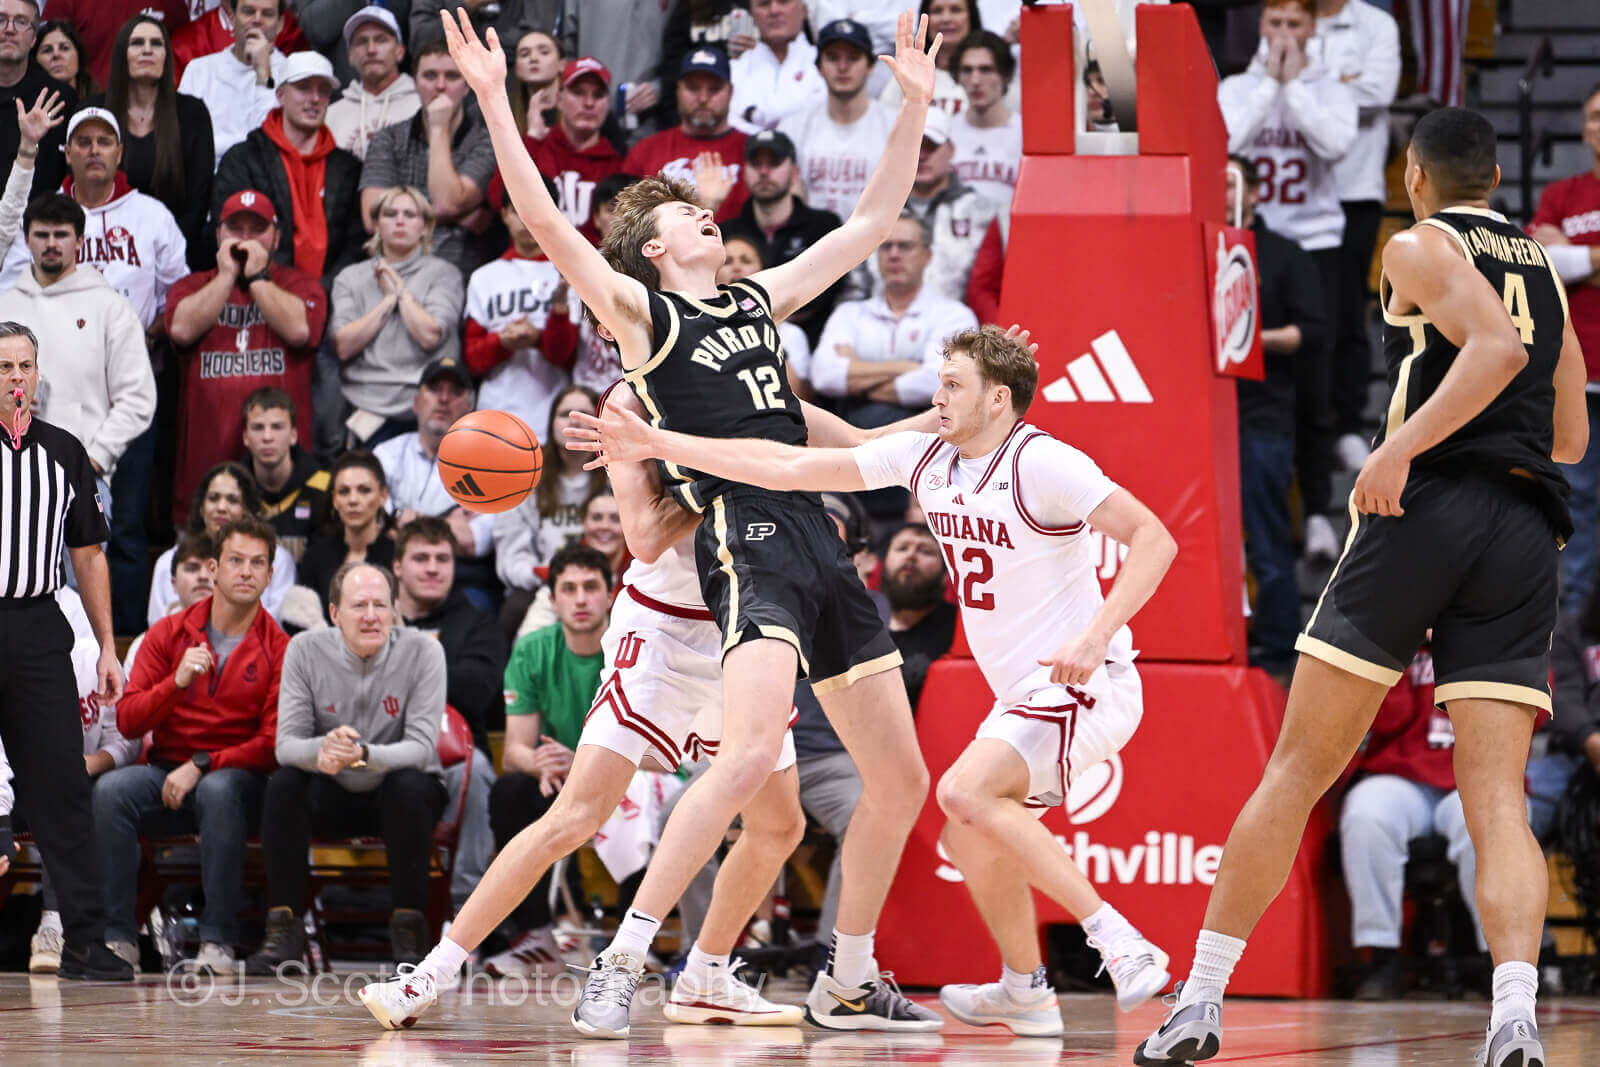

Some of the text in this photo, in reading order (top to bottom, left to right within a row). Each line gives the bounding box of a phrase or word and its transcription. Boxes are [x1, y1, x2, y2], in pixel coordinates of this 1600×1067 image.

[75, 235, 142, 267] DIANA
[1503, 271, 1535, 345] 4
[200, 348, 285, 379] HOOSIERS
[736, 365, 787, 410] 12
[927, 511, 1015, 550] NDIANA
